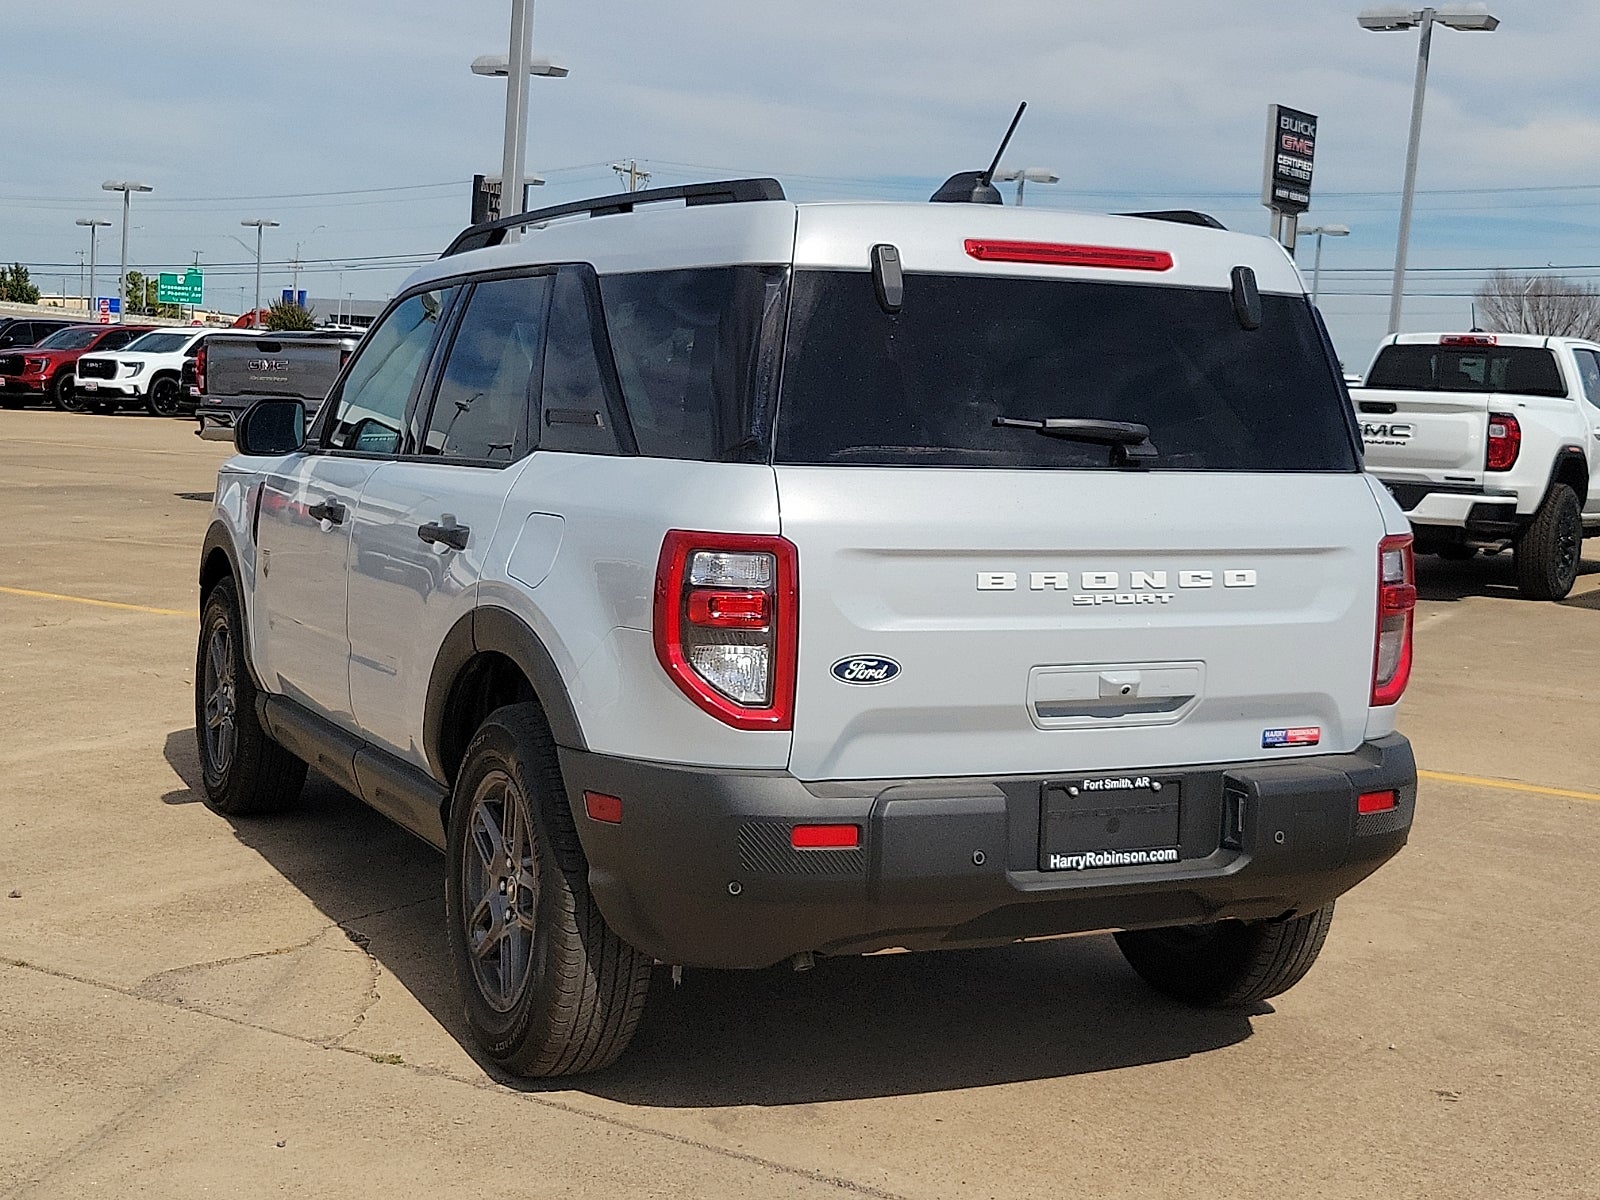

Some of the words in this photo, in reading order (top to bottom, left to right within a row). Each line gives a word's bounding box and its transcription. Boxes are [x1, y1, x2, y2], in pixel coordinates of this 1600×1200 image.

[1280, 116, 1315, 137] BUICK
[1281, 135, 1314, 155] GMC
[1277, 154, 1313, 172] CERTIFIED
[247, 359, 289, 371] GMC
[1361, 422, 1412, 438] MC
[976, 569, 1257, 591] BRONCO
[1072, 592, 1175, 606] SPORT
[844, 660, 889, 680] Ford
[1083, 779, 1103, 790] Fort
[1135, 777, 1150, 788] AR
[1050, 849, 1178, 870] HarryRobinson.com
